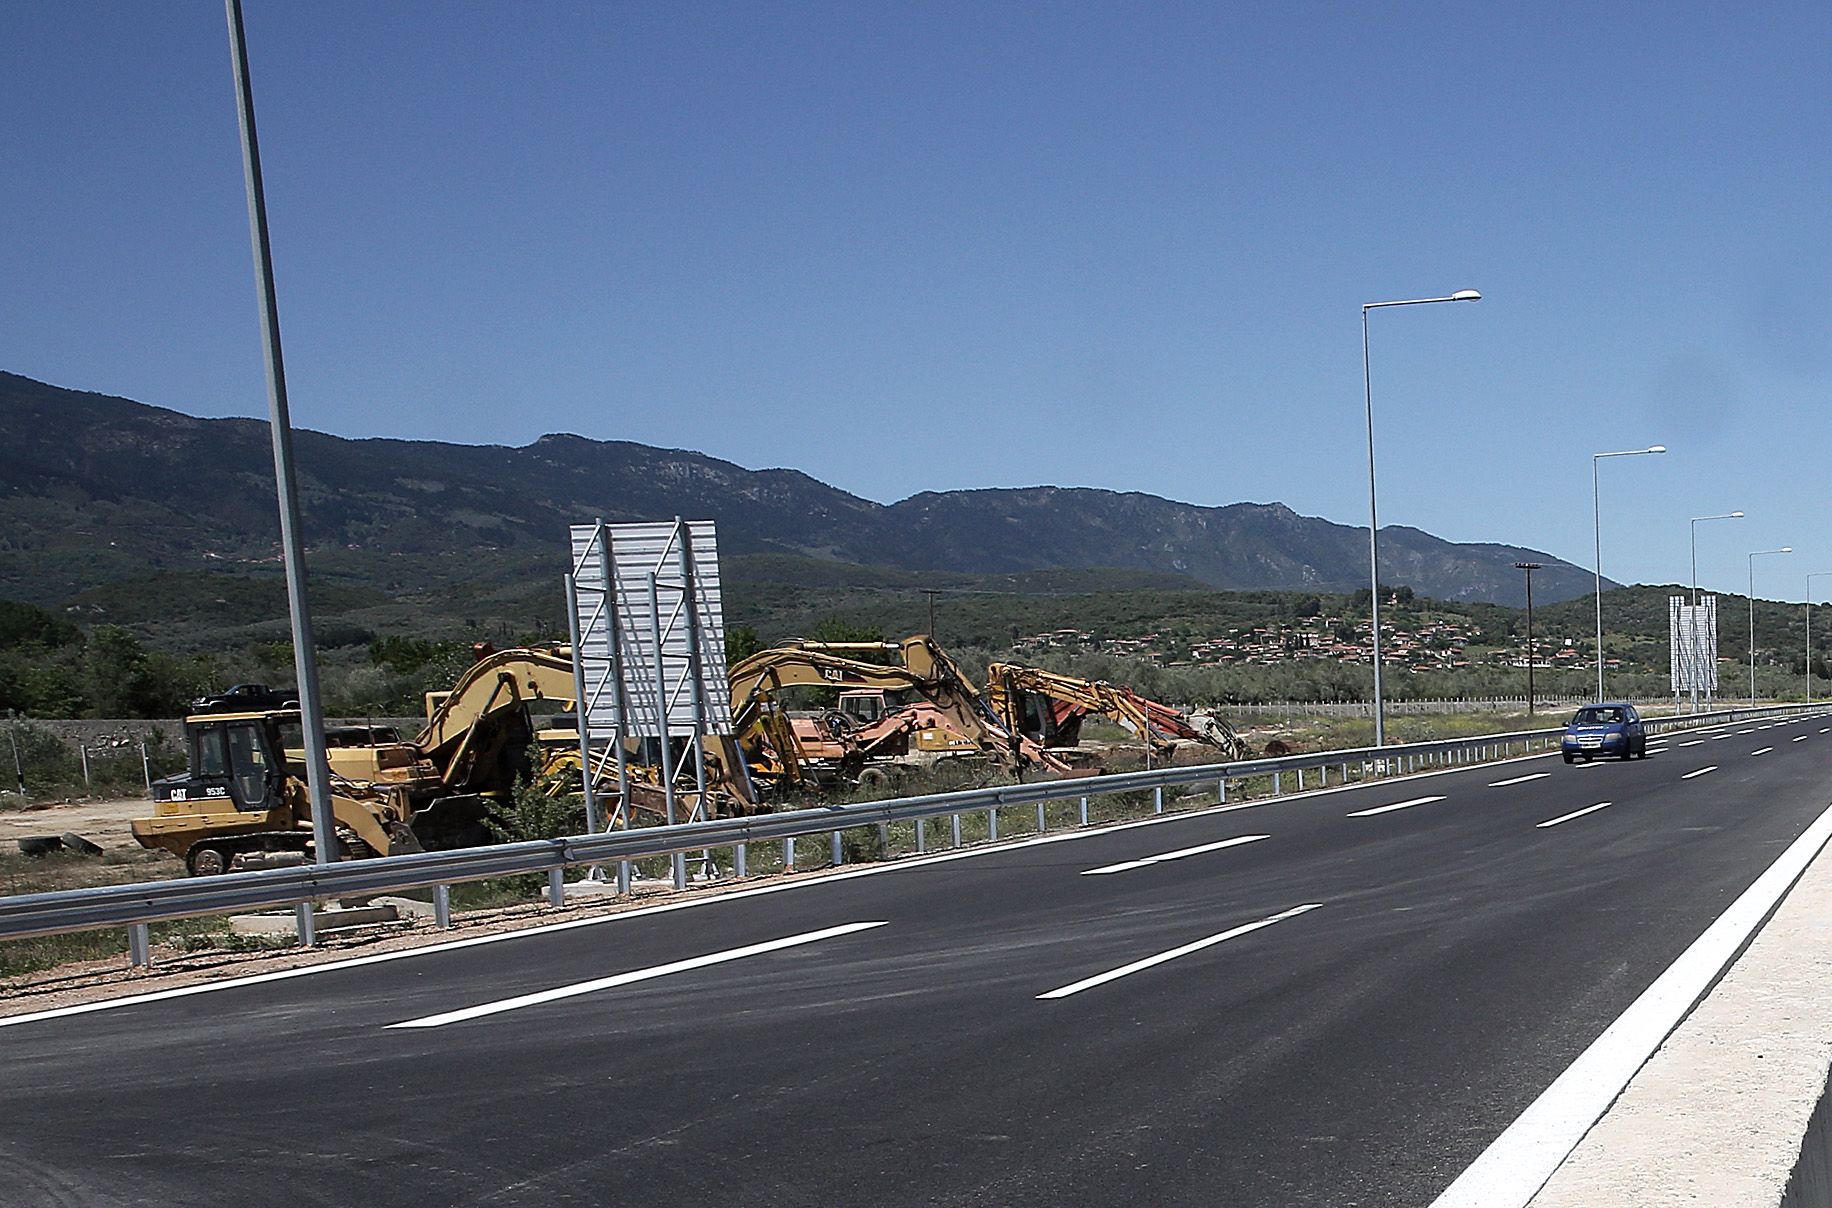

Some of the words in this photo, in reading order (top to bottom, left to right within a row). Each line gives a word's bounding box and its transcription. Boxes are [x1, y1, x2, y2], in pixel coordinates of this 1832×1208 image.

[824, 669, 843, 681] CAT
[170, 788, 187, 801] CAT
[206, 786, 226, 796] 953C
